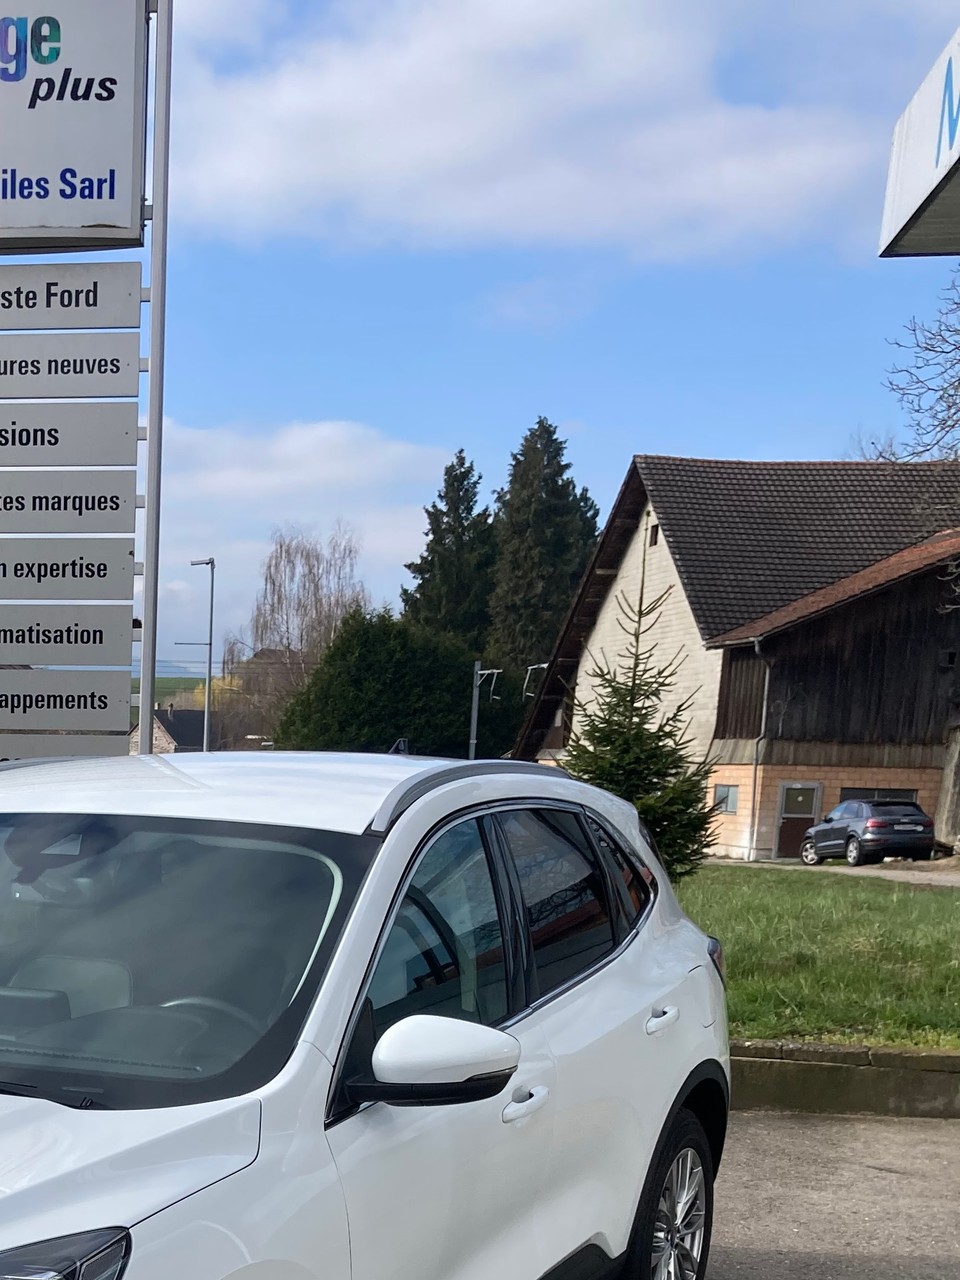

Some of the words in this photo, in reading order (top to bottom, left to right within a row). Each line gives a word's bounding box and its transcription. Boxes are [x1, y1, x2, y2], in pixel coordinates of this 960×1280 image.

[27, 67, 118, 109] plus
[59, 168, 115, 200] Sarl
[45, 281, 98, 308] Ford
[47, 356, 121, 375] neuves
[32, 492, 120, 516] marques
[13, 557, 108, 583] expertise
